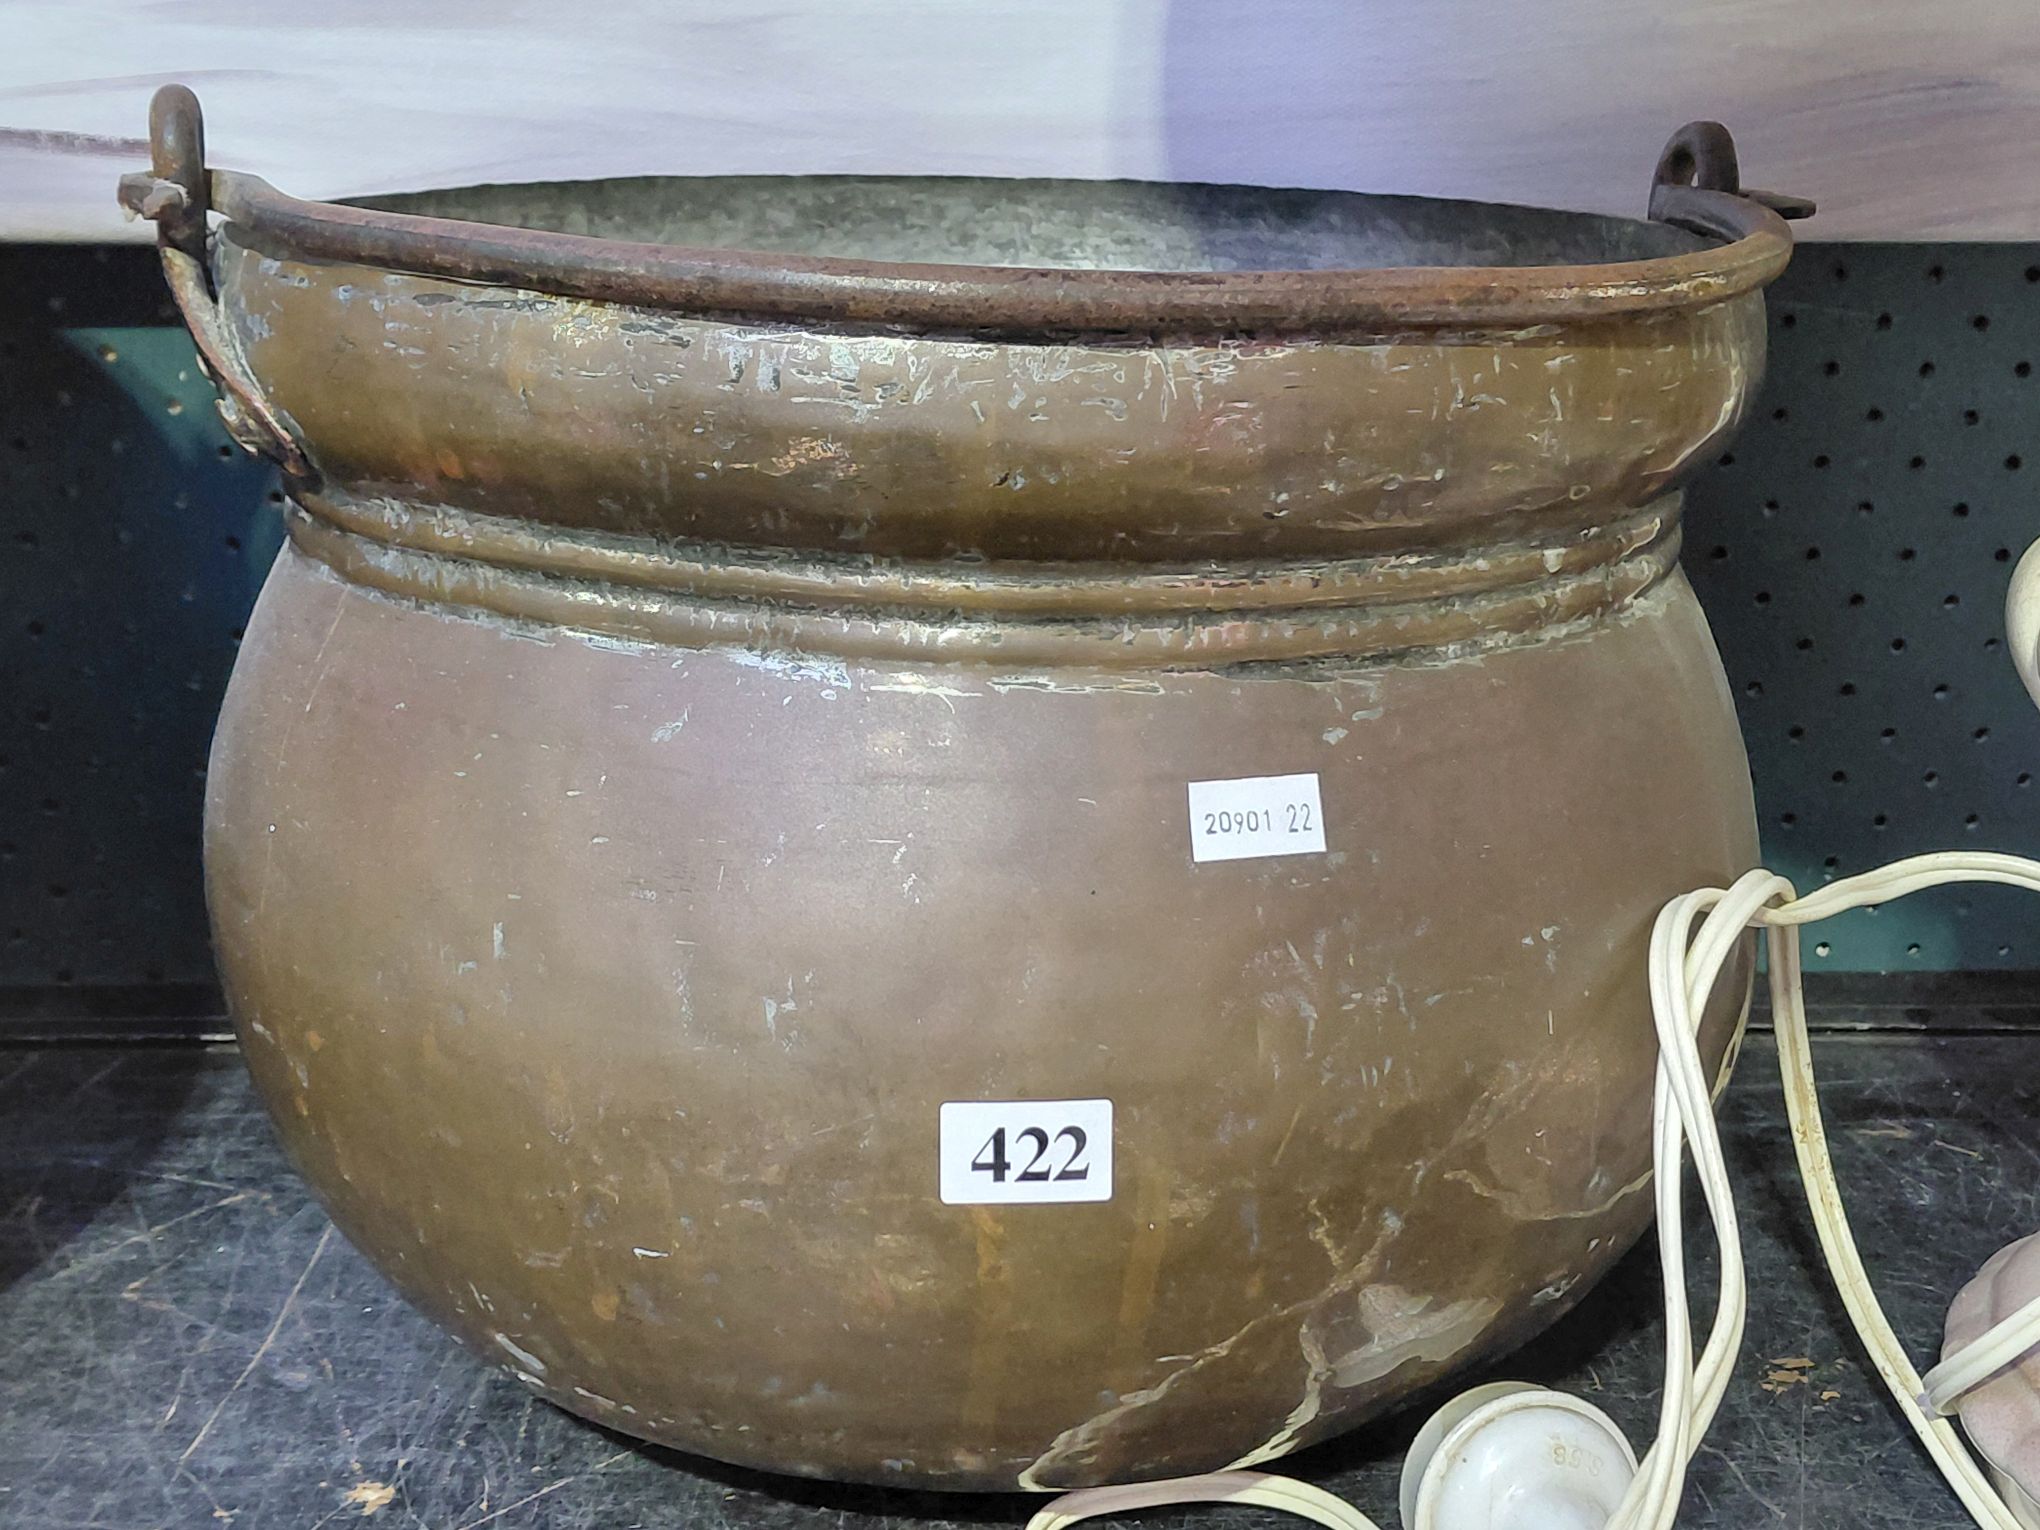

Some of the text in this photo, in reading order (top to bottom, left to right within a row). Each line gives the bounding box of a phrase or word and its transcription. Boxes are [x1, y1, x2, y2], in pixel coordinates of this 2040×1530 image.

[1204, 803, 1313, 835] 20901 22
[971, 1126, 1090, 1183] 422
